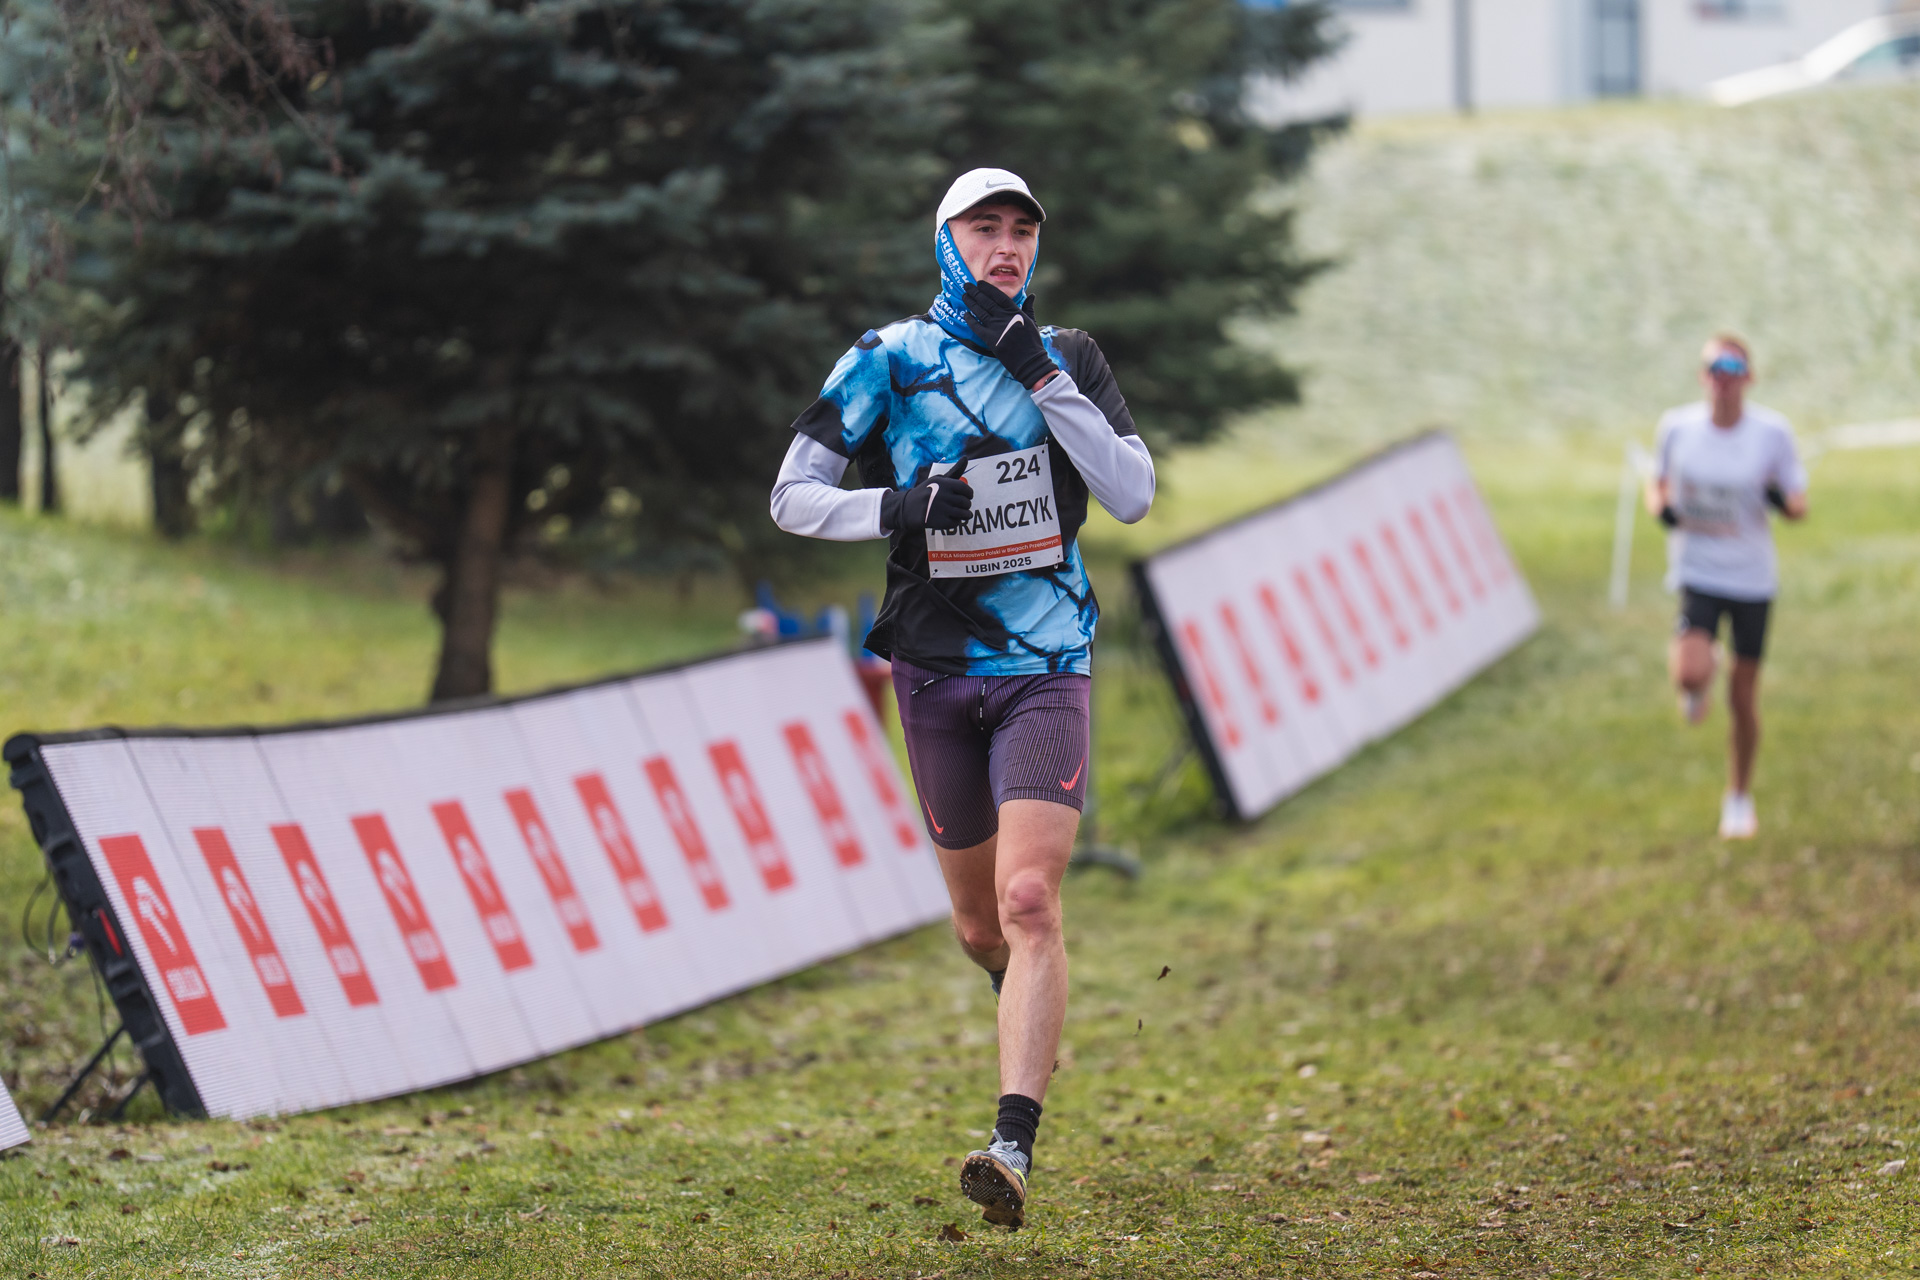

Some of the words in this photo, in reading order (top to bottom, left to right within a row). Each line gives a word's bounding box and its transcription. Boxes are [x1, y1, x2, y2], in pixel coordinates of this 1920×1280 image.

[996, 454, 1040, 484] 224
[931, 495, 1053, 536] RAMCZYK
[1007, 545, 1029, 553] Biegach
[965, 562, 1000, 573] LUBIN
[1003, 556, 1032, 569] 2025
